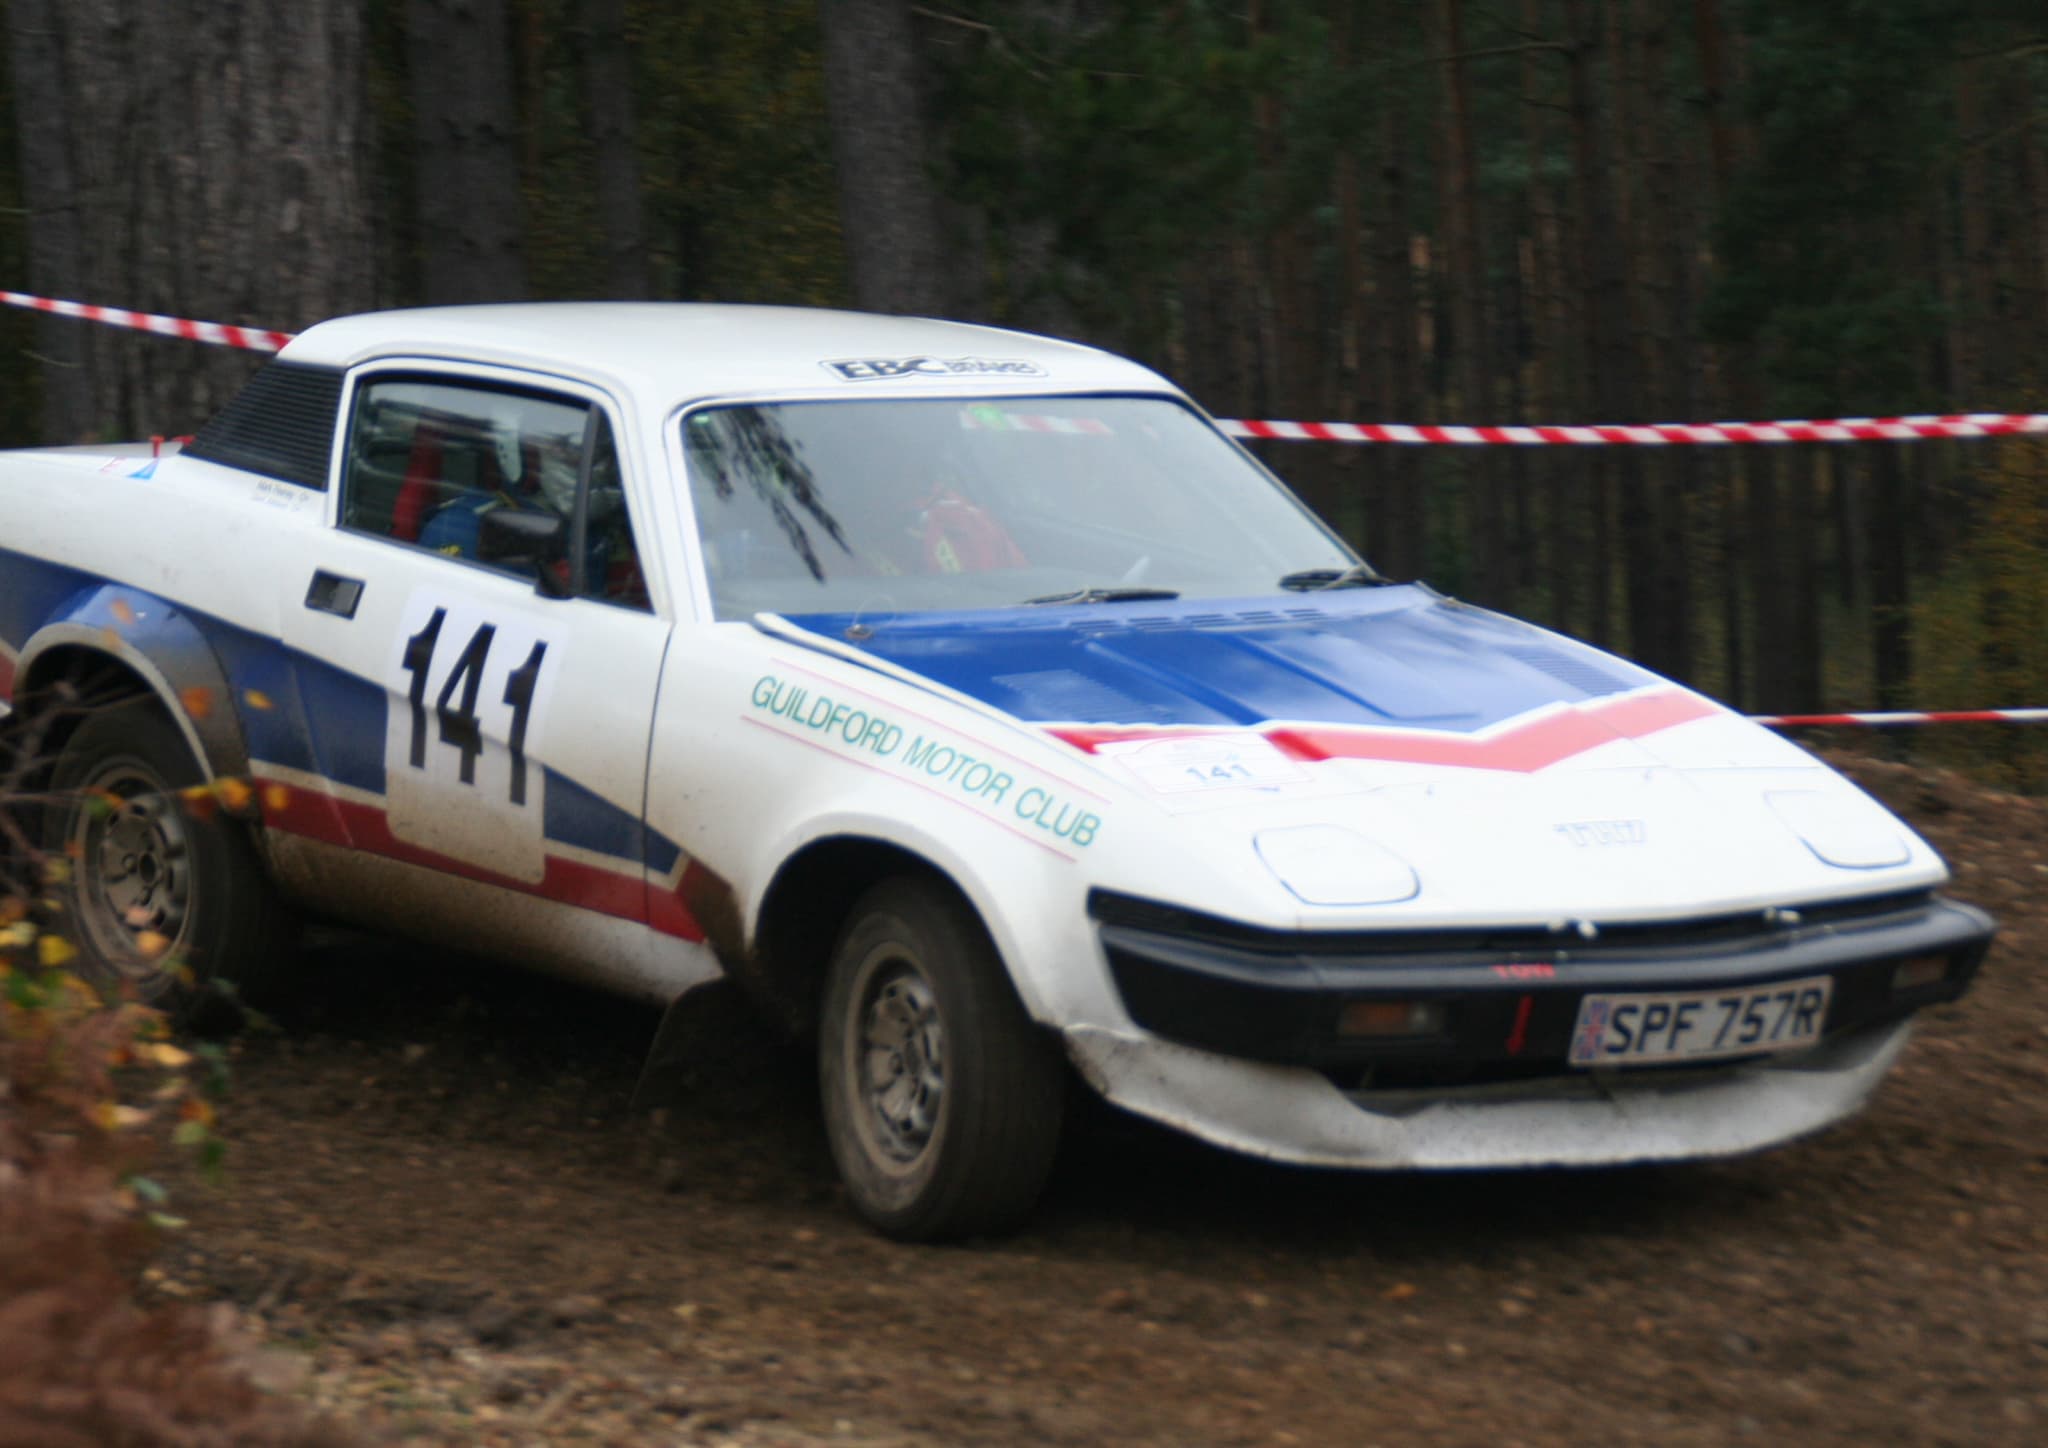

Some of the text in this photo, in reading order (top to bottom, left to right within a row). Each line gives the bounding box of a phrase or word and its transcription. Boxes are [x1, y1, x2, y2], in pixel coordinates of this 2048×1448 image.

[831, 358, 946, 379] EBC
[402, 606, 549, 806] 141
[751, 675, 1102, 847] GUILDFORD MOTOR CLUB
[1186, 763, 1254, 785] 141
[1605, 988, 1824, 1054] SPF 757R
